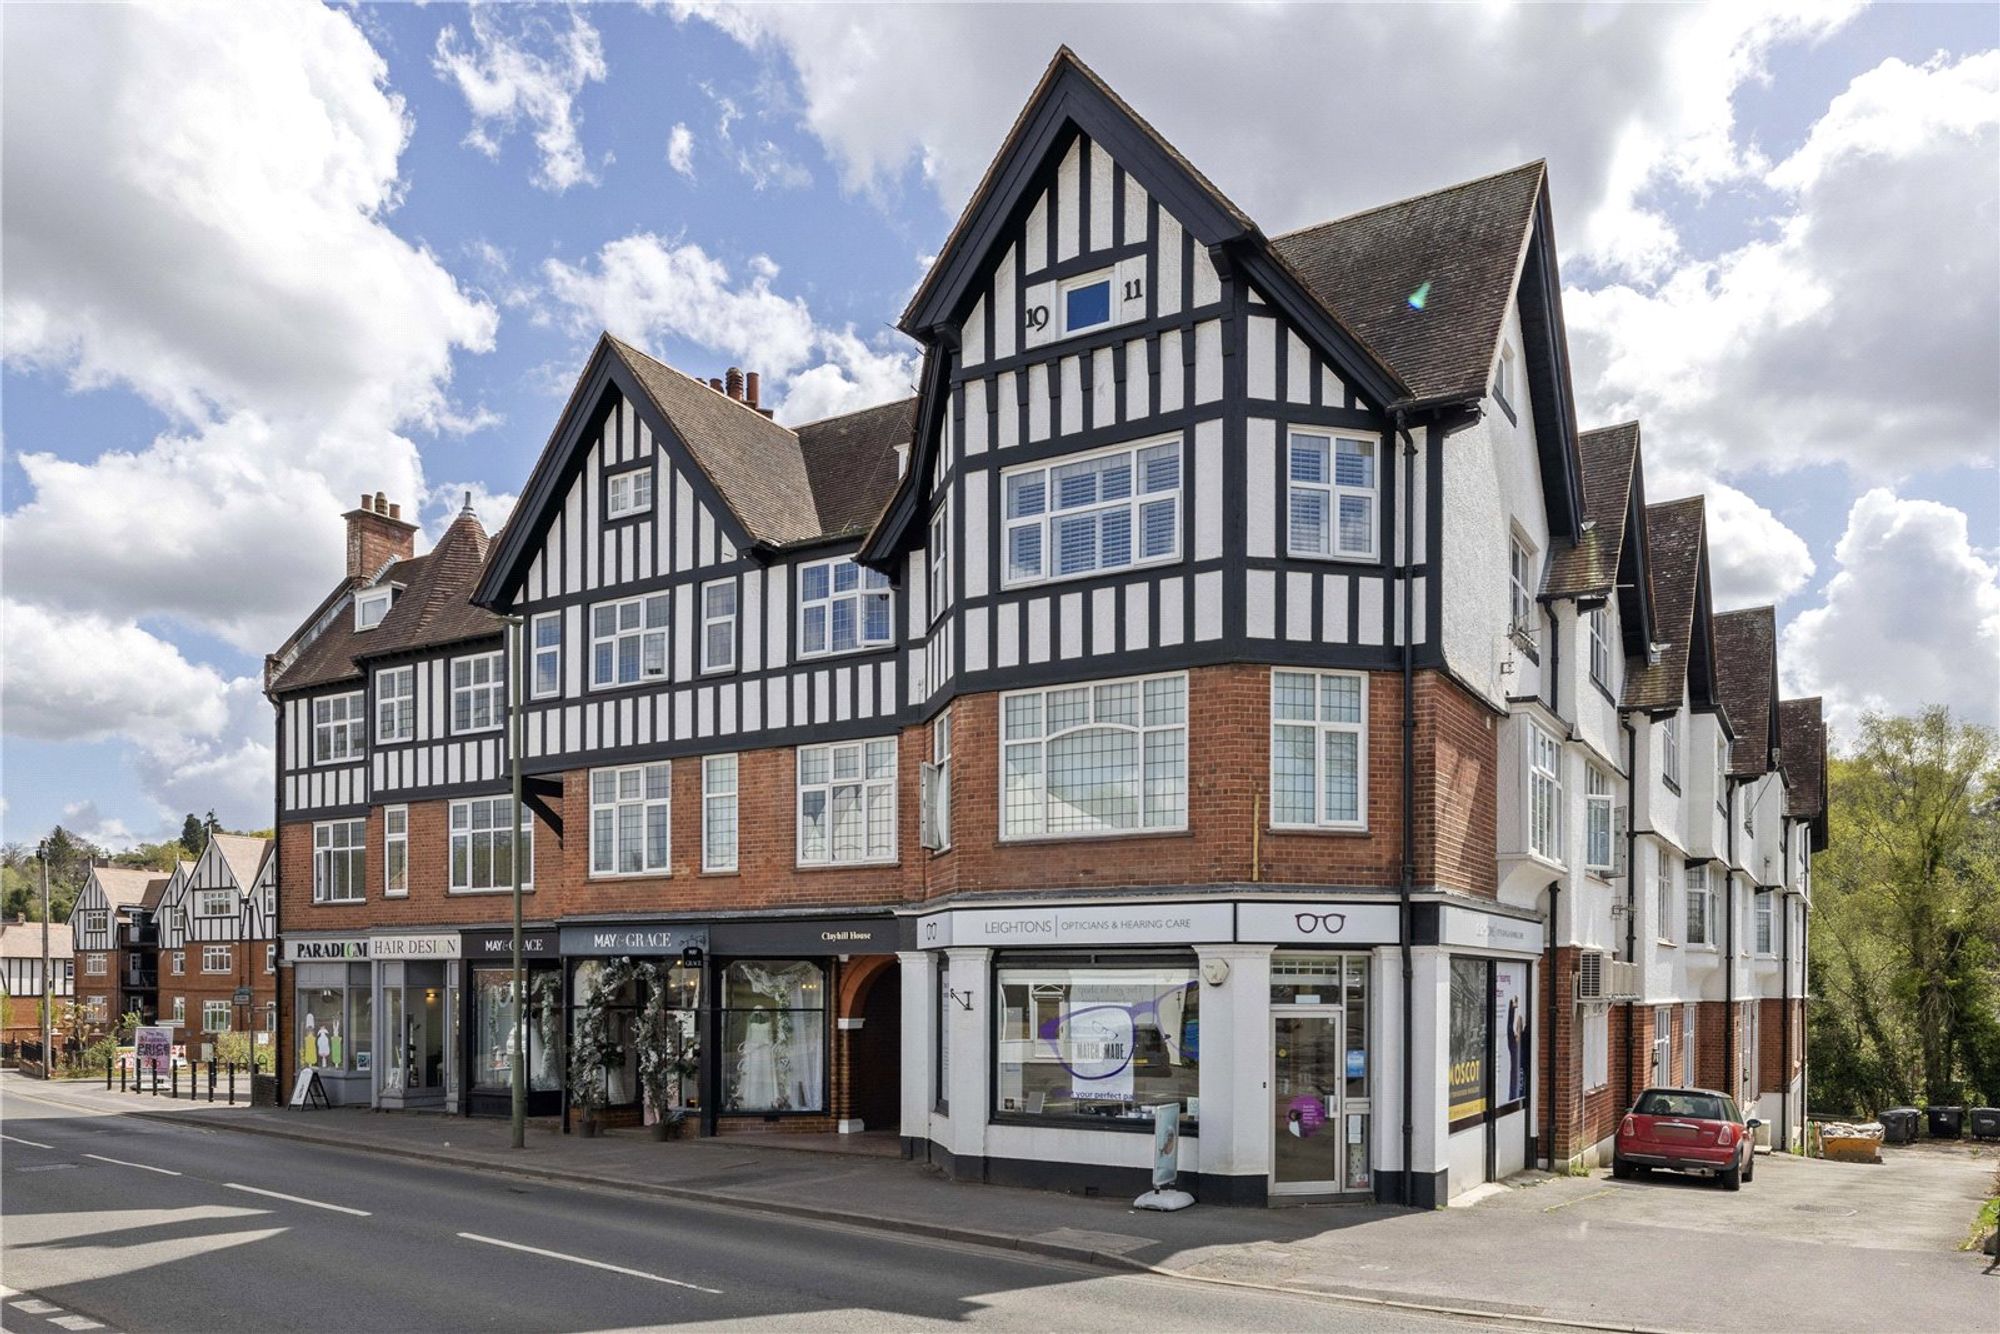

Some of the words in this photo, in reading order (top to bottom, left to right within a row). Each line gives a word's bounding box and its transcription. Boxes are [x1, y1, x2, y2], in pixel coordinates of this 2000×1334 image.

[1026, 305, 1049, 332] 19
[1123, 278, 1143, 302] 11
[985, 920, 1052, 934] LEIGHTONS
[1061, 920, 1109, 931] OPTICIANS
[1111, 921, 1117, 929] &
[1120, 919, 1163, 930] HEARING
[1166, 918, 1192, 929] CARE
[821, 931, 848, 942] Clayhill
[849, 931, 871, 940] House
[297, 942, 368, 958] PARADIGM
[374, 940, 405, 955] HAIR
[408, 939, 456, 955] DESIGN
[137, 1043, 170, 1052] PRICE
[1075, 1091, 1093, 1099] your
[1094, 1090, 1122, 1101] perfect
